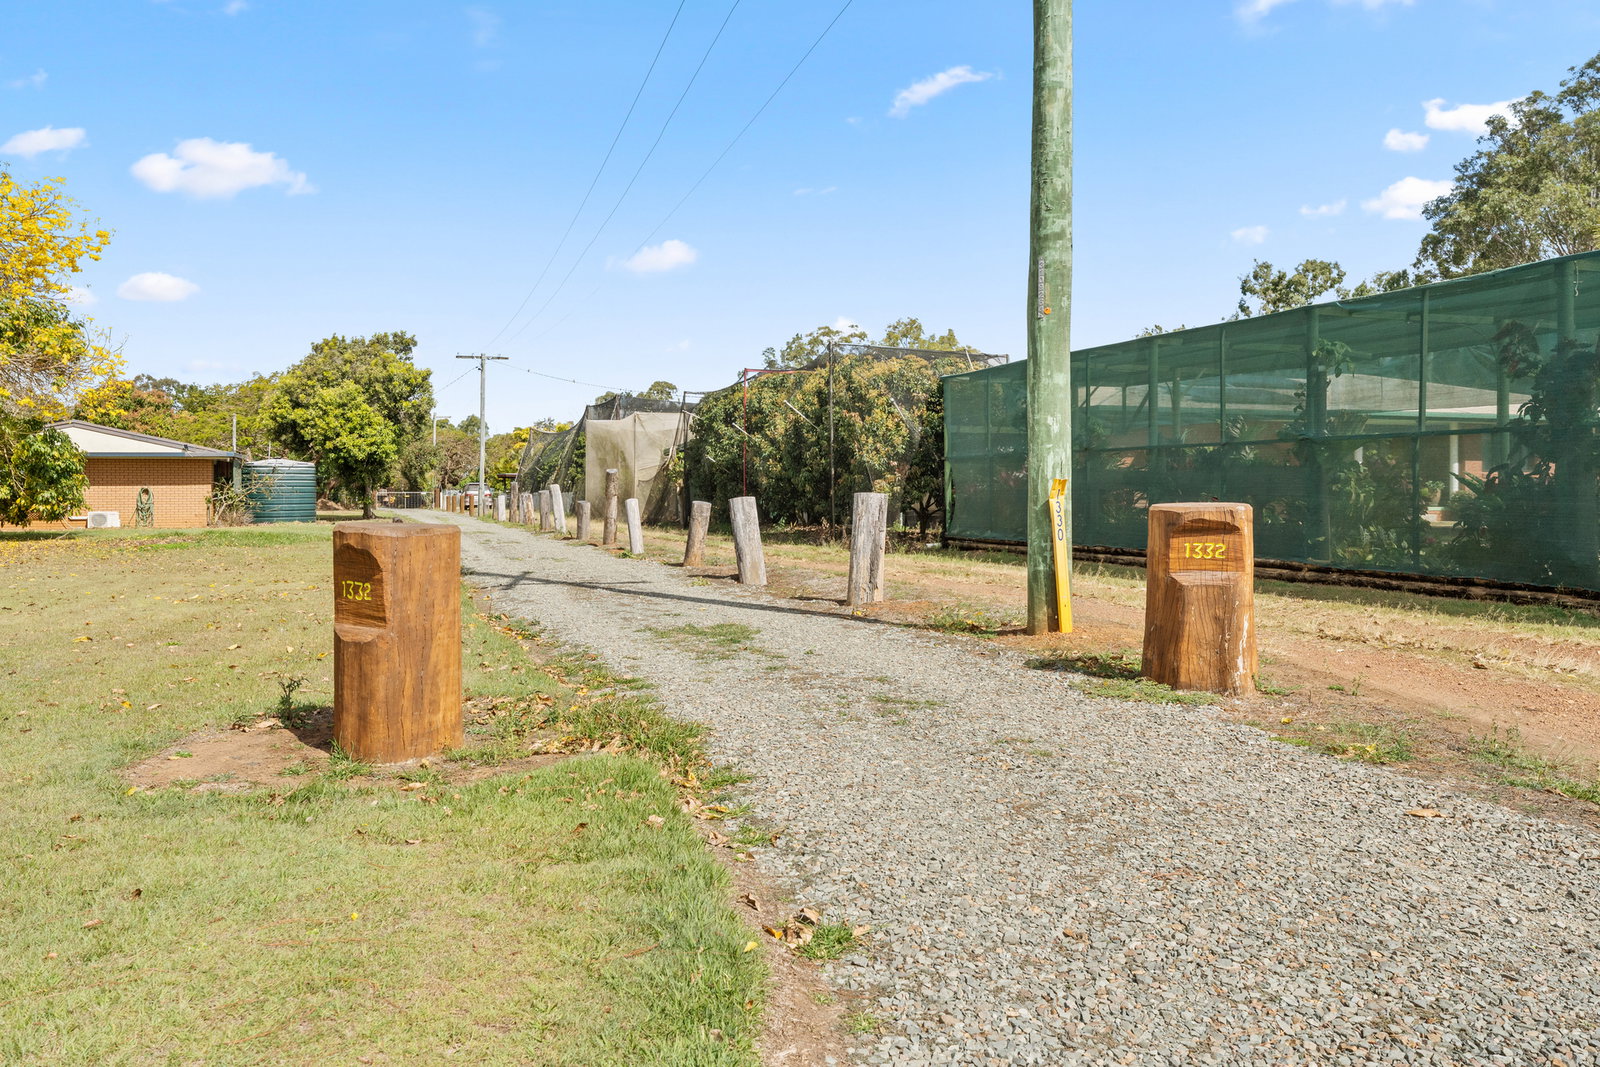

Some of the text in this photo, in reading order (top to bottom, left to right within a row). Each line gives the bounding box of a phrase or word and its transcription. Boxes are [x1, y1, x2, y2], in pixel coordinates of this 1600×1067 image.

[1055, 488, 1064, 541] 1330
[1184, 542, 1226, 559] 1332
[341, 580, 372, 600] 1332
